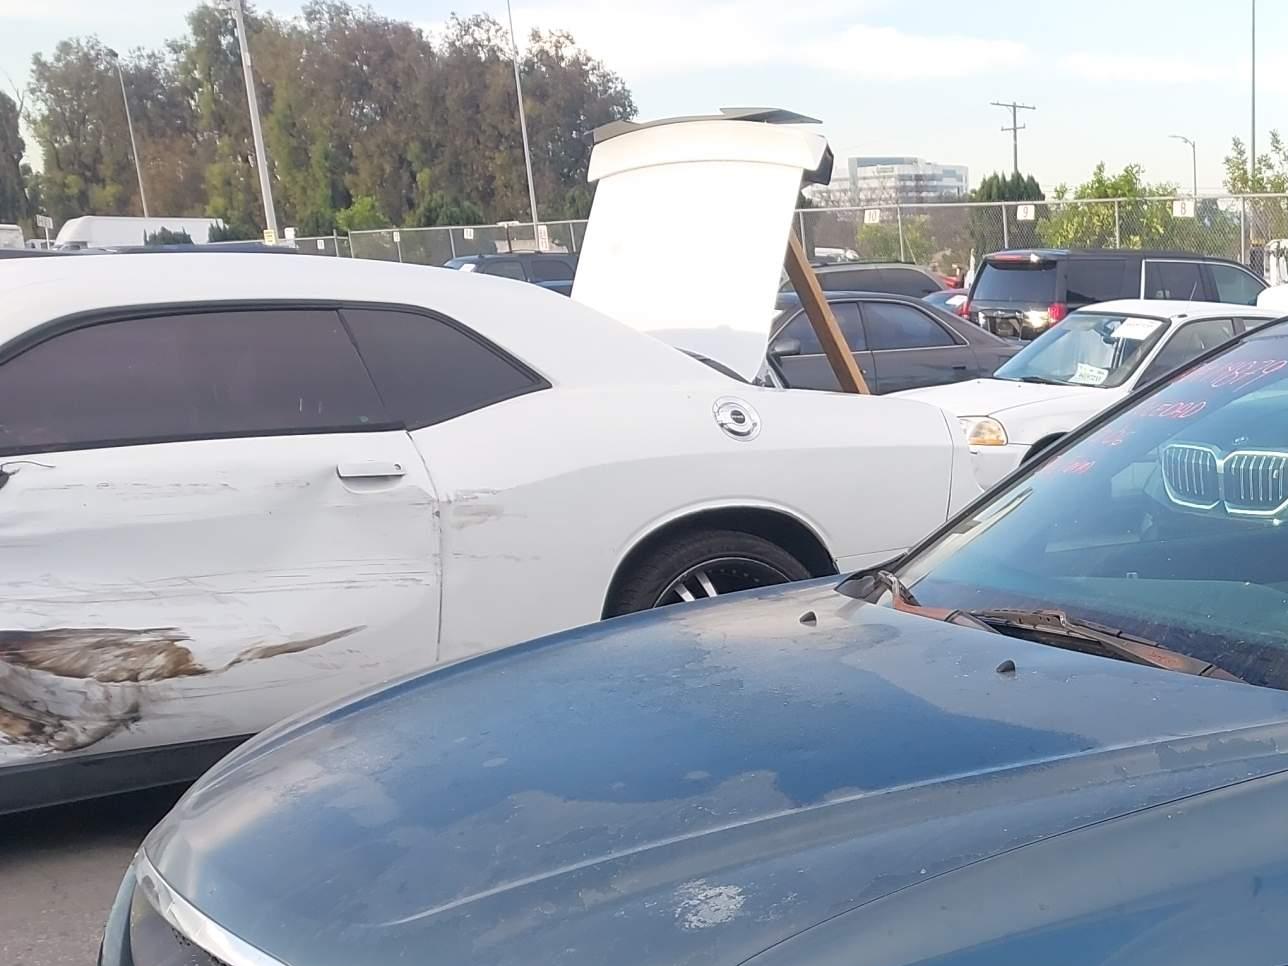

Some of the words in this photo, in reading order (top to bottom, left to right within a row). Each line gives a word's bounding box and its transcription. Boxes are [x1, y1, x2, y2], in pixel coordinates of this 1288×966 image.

[867, 209, 878, 222] 10
[1022, 206, 1028, 218] 9
[1180, 202, 1186, 216] 8
